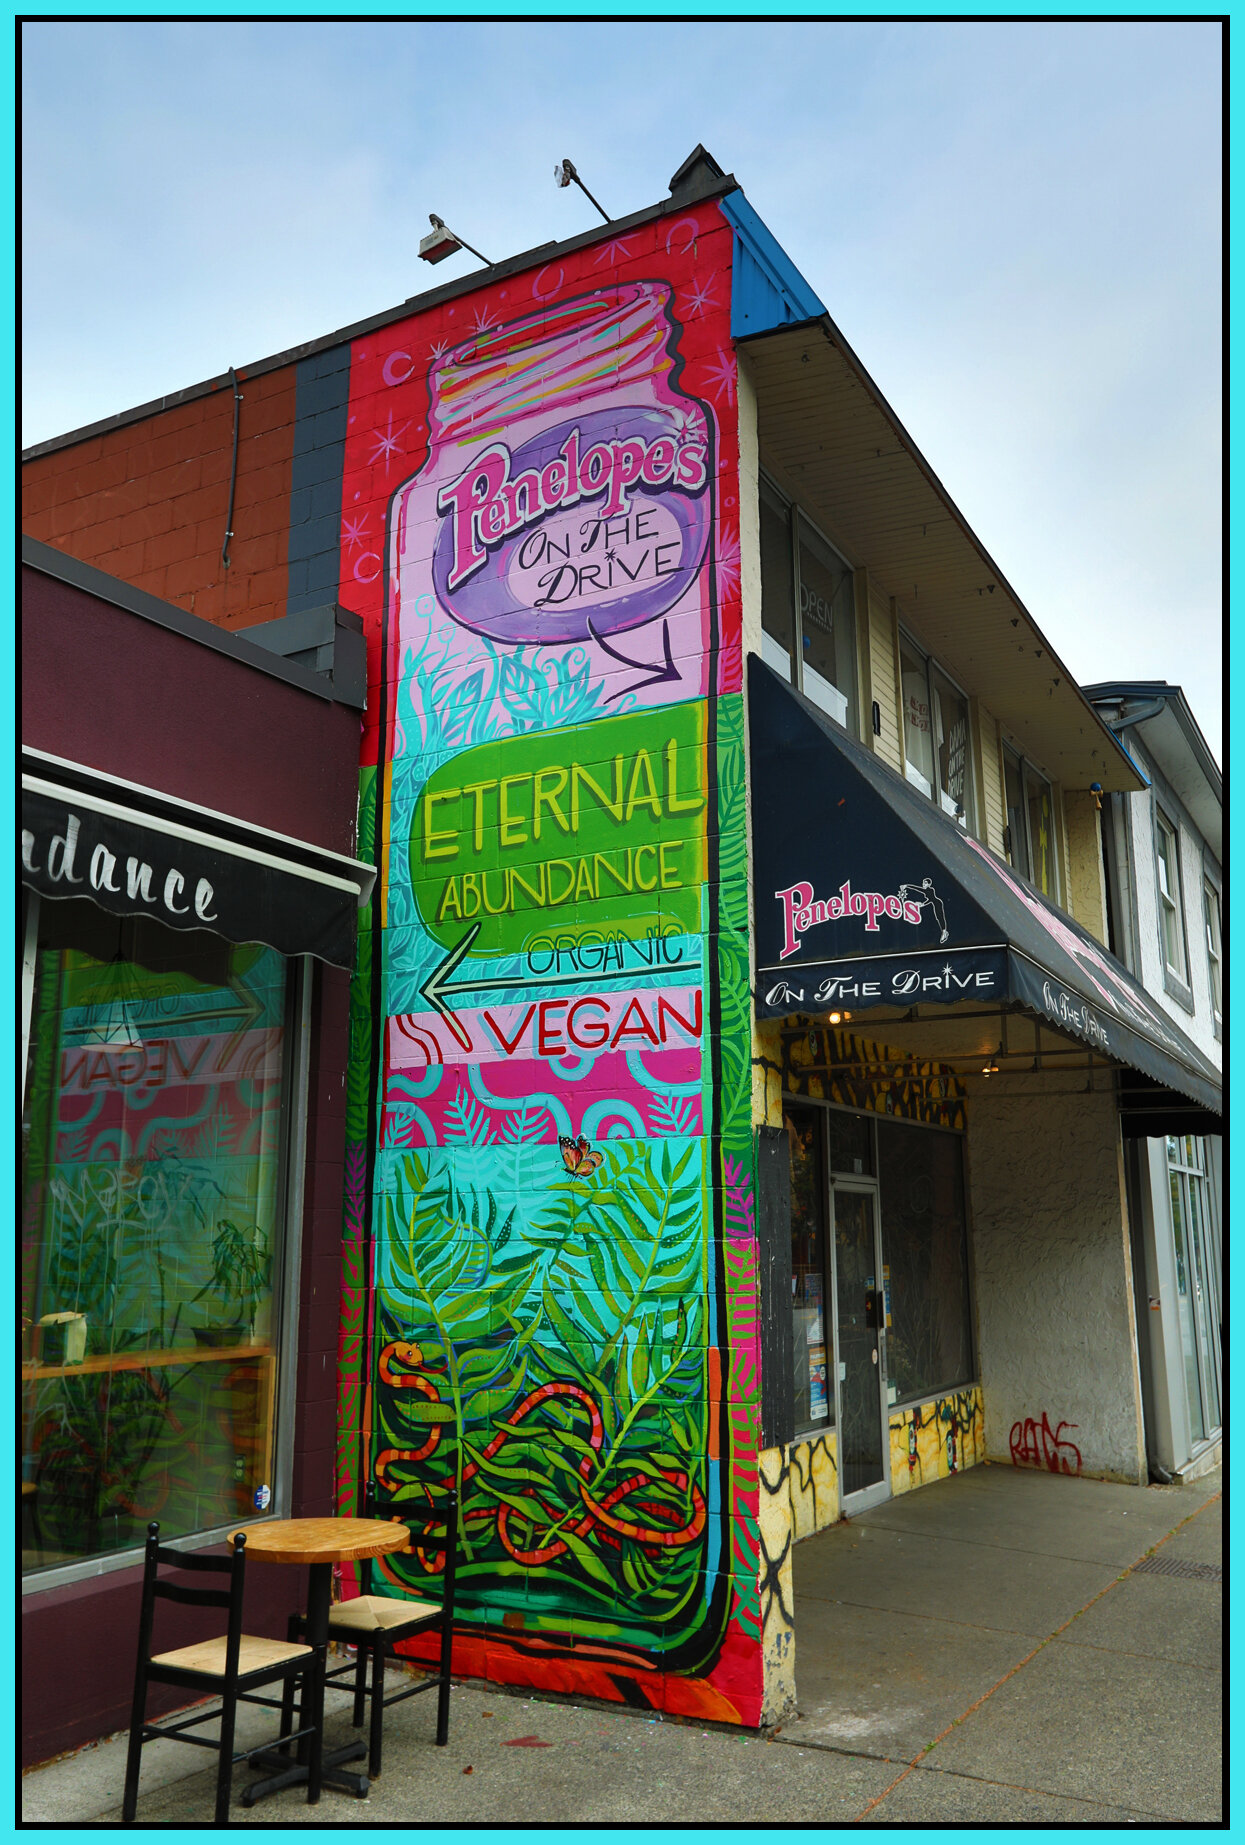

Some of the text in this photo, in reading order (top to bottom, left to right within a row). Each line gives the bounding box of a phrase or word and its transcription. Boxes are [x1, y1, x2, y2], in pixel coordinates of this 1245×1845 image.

[579, 509, 658, 552] THE
[800, 582, 832, 627] OPEN
[423, 738, 704, 861] ETERNAL
[438, 841, 684, 921] ABUNDANCE
[527, 923, 684, 974] ORGANIC
[814, 976, 881, 1001] THE
[480, 990, 703, 1056] VEGAN
